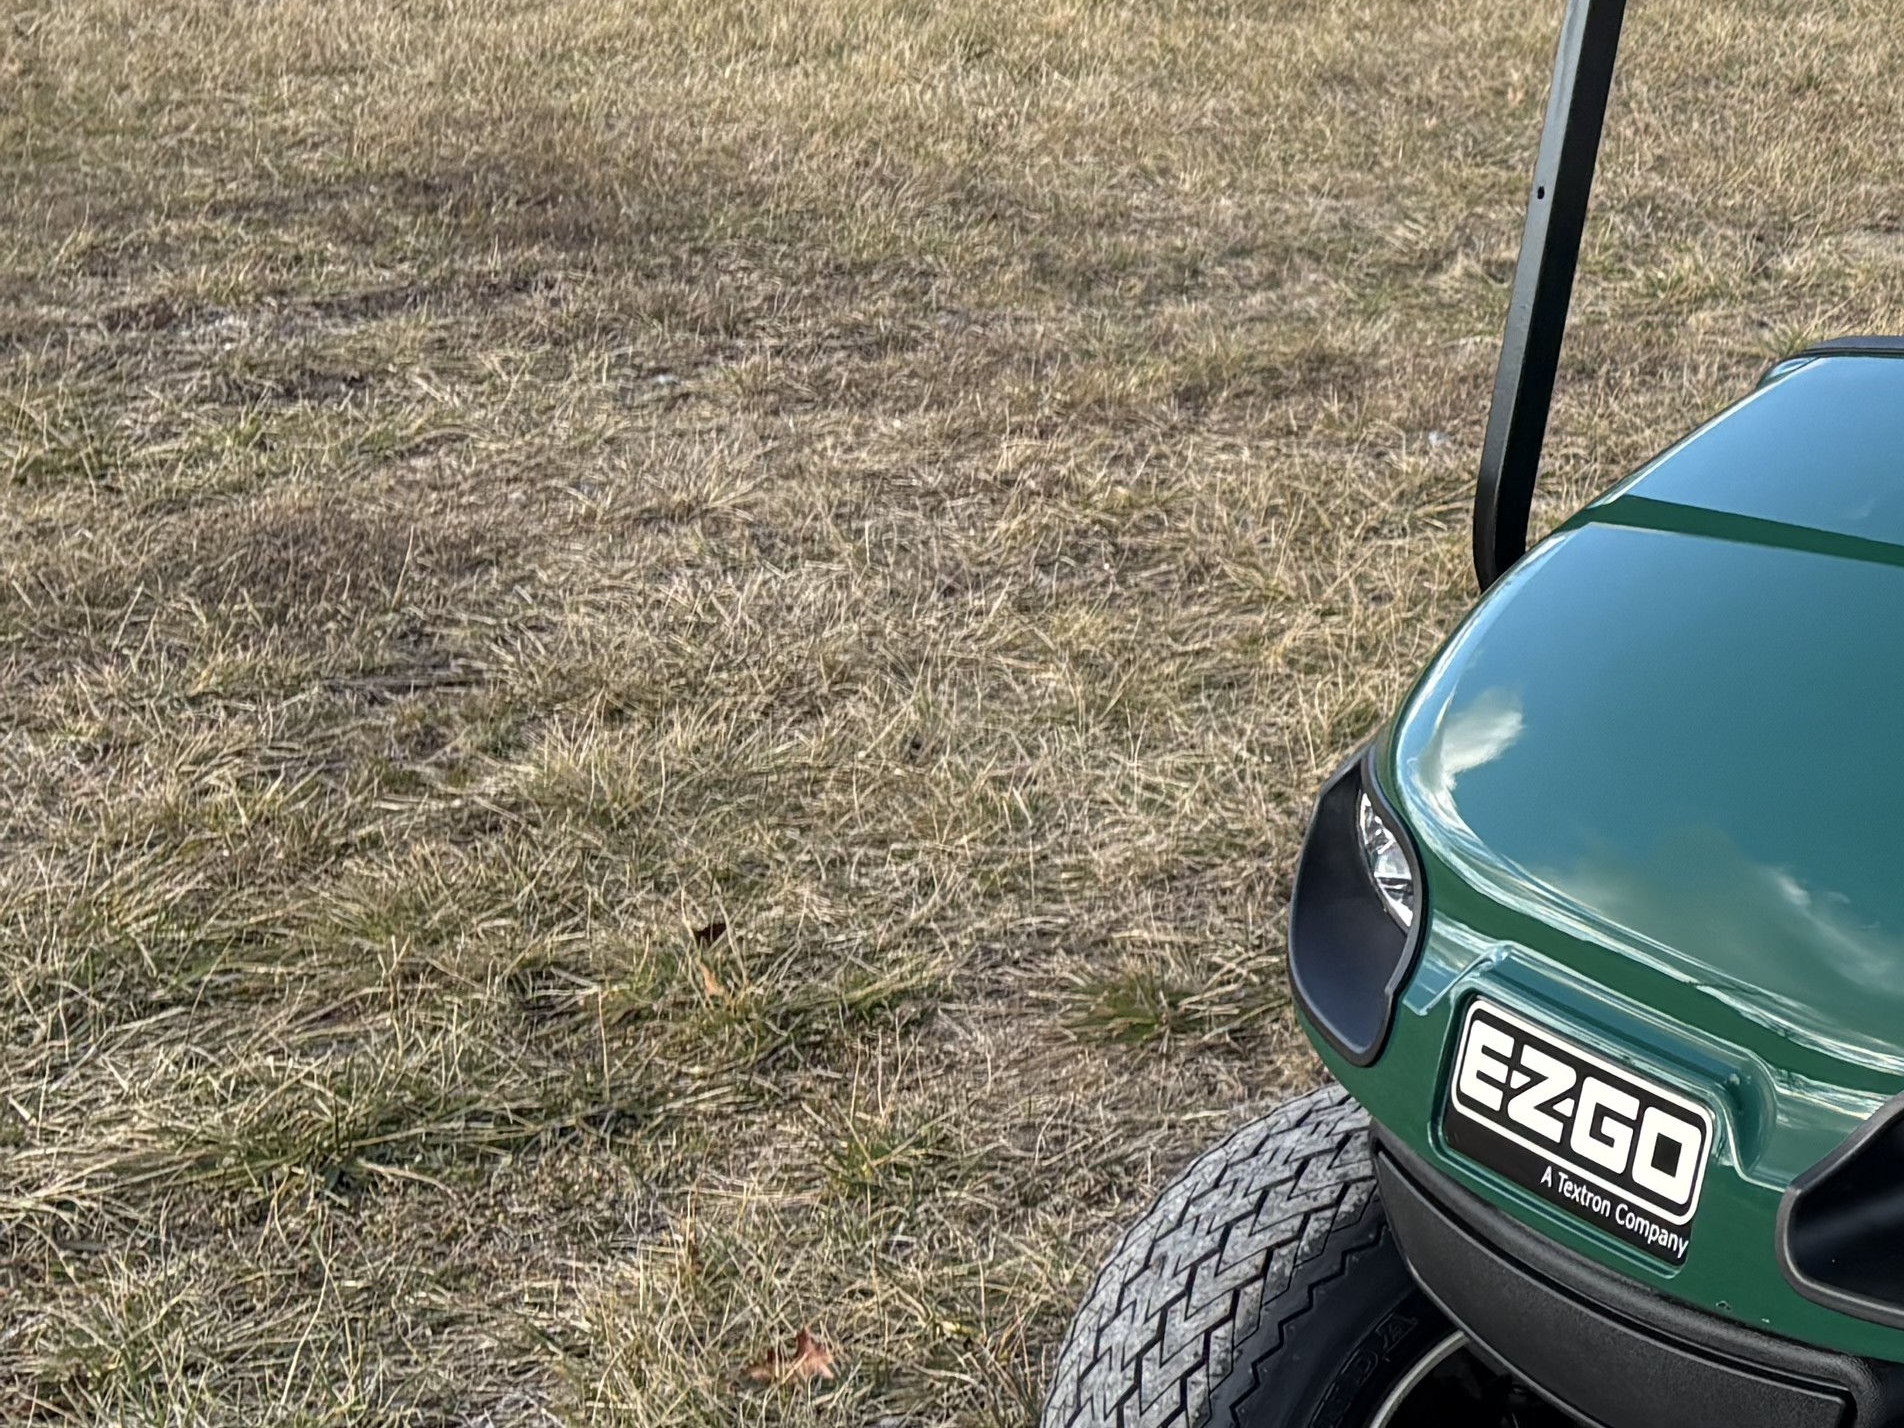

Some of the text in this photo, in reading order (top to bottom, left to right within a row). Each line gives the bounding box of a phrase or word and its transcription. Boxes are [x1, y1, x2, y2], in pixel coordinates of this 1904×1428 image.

[1540, 1165, 1689, 1259] A Textron Company
